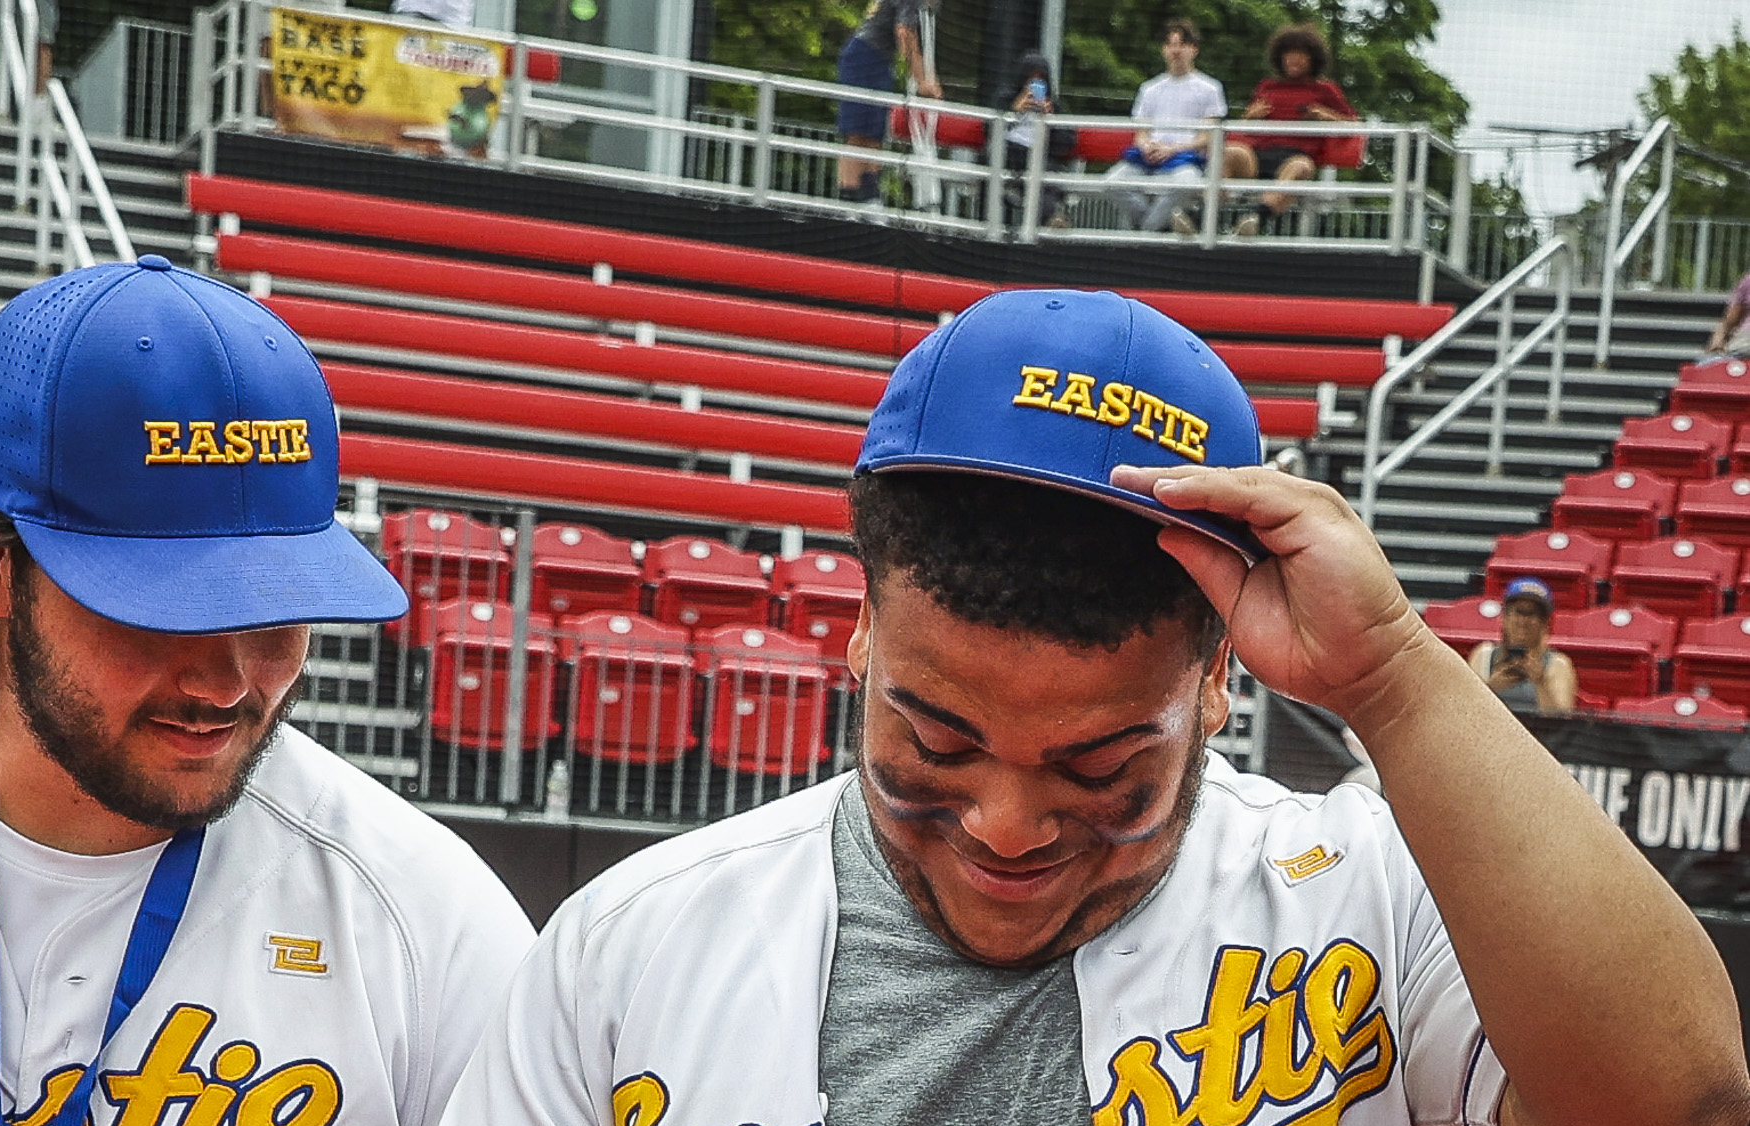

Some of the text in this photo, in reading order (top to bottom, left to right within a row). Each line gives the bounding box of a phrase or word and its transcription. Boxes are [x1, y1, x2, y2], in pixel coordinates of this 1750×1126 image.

[282, 28, 365, 58] BASE
[280, 73, 364, 104] TACO
[1013, 364, 1210, 464] EASTIE
[144, 418, 312, 466] EASTIE
[1637, 770, 1750, 851] ONLY
